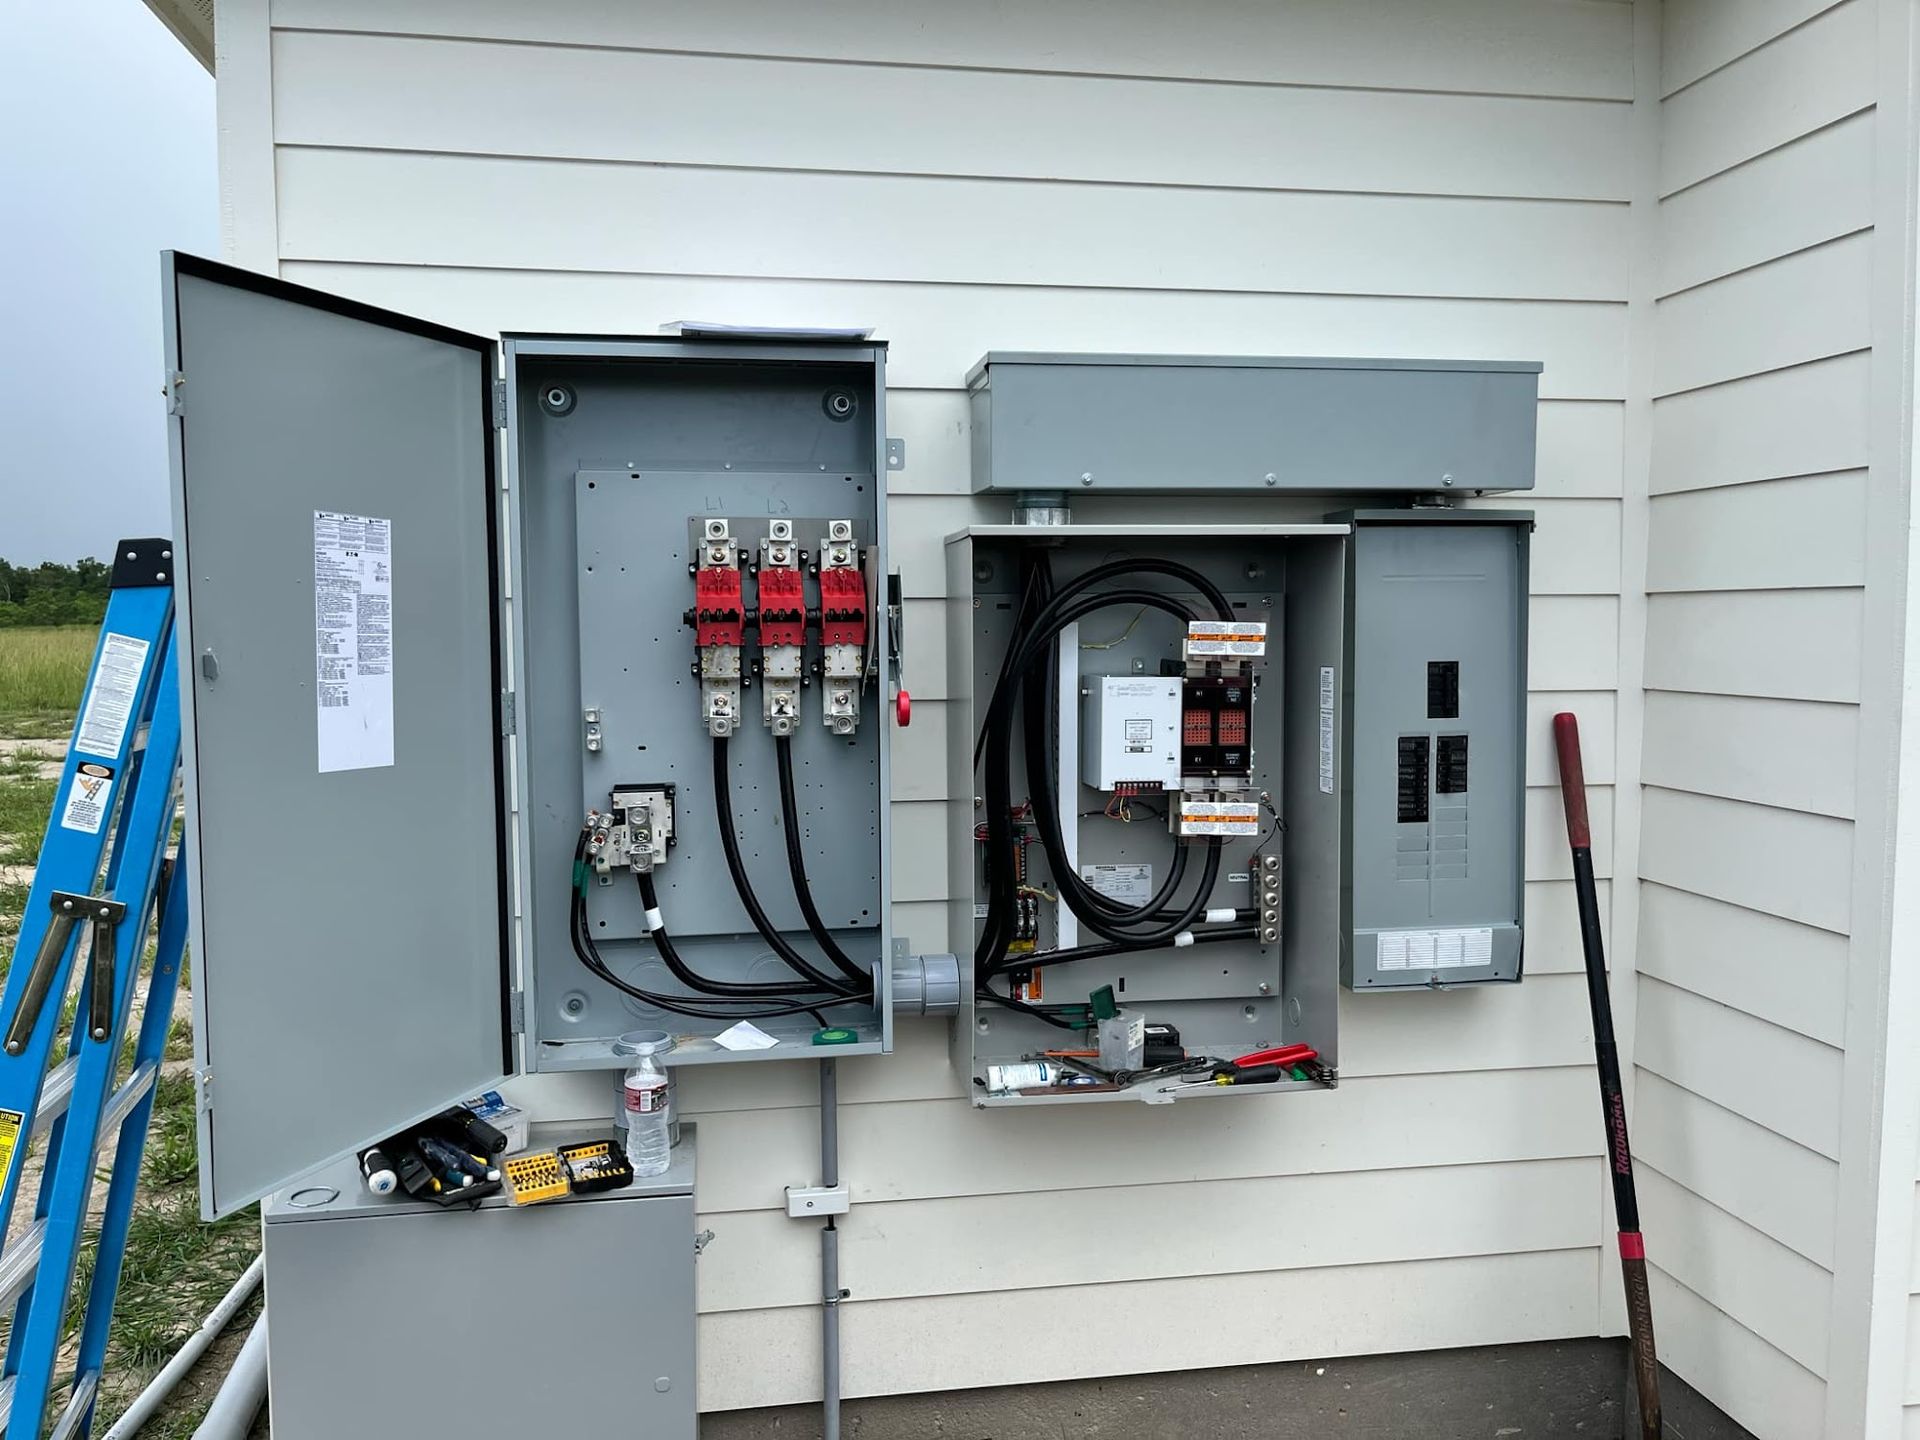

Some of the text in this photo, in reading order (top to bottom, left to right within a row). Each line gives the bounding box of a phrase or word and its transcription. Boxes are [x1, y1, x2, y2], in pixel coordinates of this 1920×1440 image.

[705, 496, 724, 511] L1
[767, 498, 790, 514] L2
[0, 1112, 20, 1122] UTION
